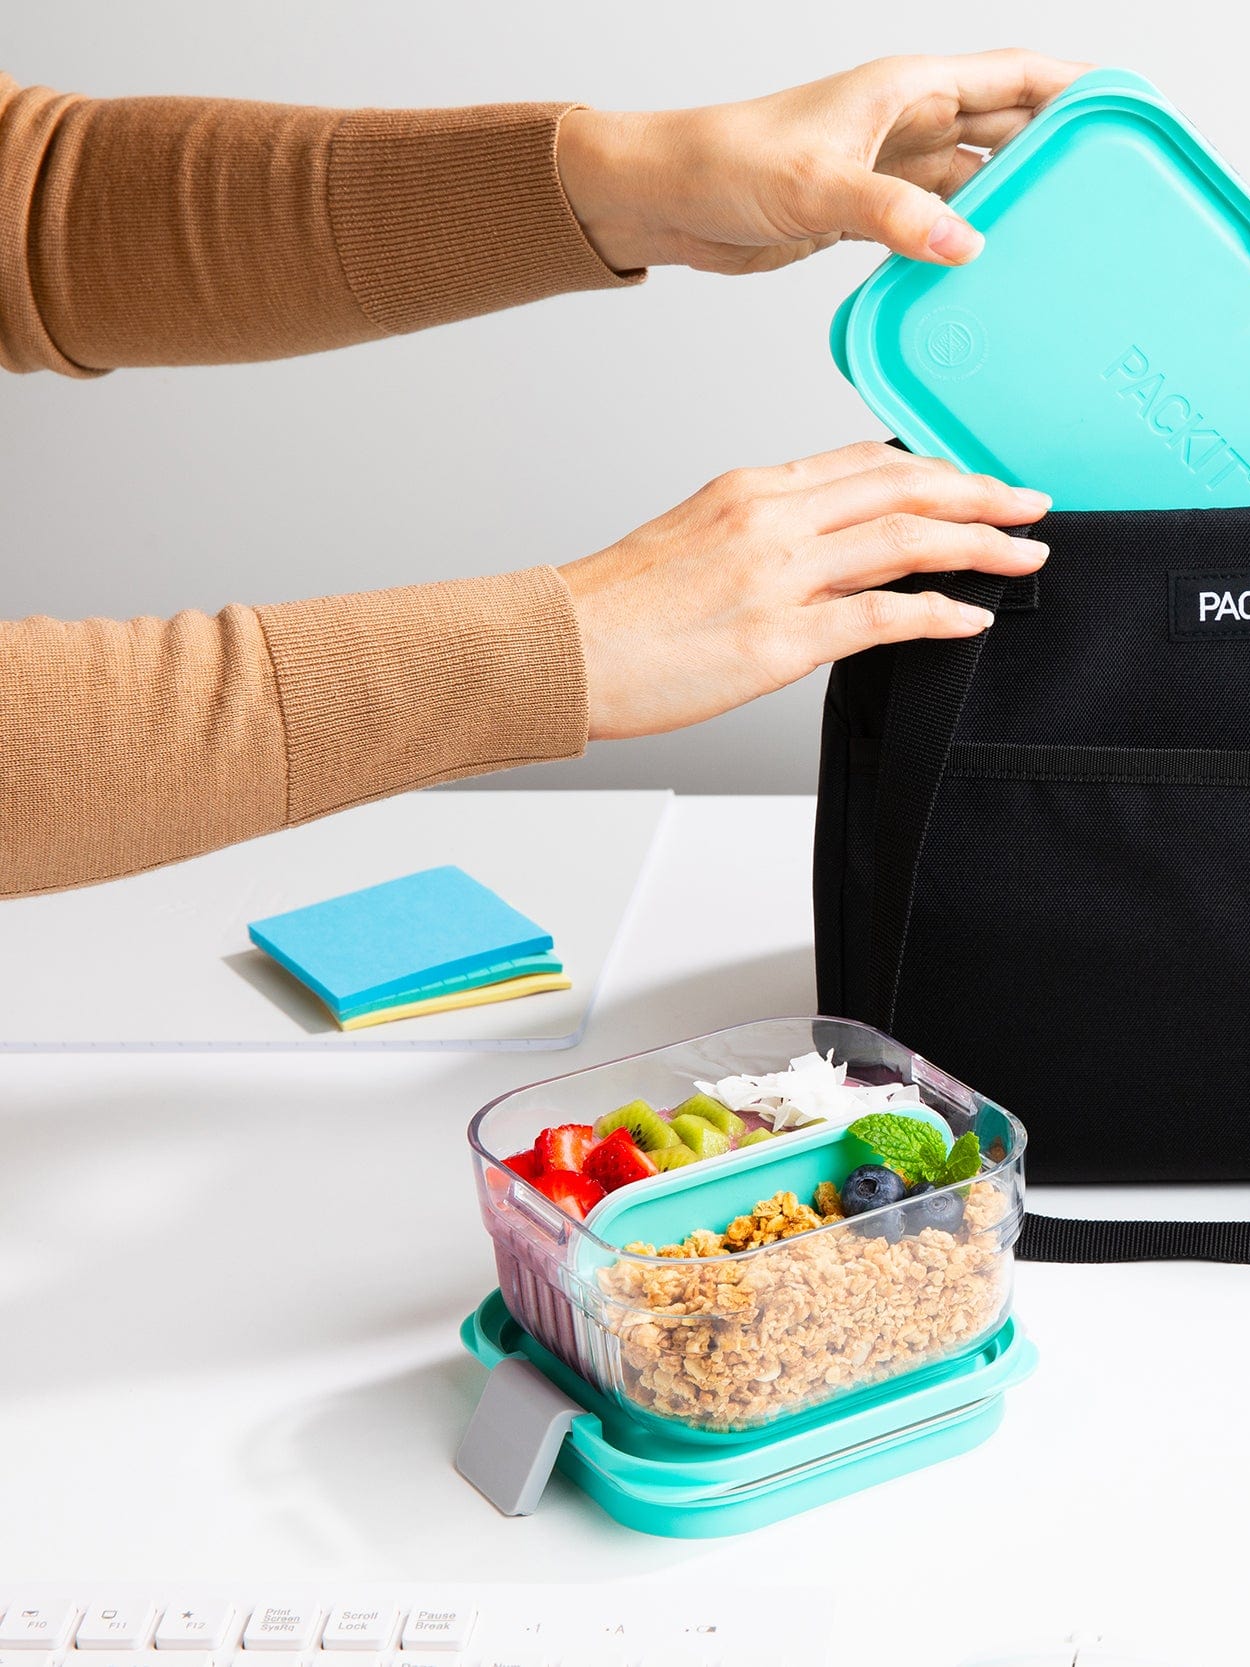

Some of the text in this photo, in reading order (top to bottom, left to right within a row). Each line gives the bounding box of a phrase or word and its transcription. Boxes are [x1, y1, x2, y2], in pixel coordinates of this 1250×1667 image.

[265, 1608, 291, 1616] Print
[342, 1611, 379, 1620] Scroll
[418, 1610, 457, 1620] Pause
[263, 1614, 301, 1623] Screen
[27, 1620, 48, 1629] F10
[108, 1621, 128, 1629] F11
[185, 1621, 206, 1629] F12
[260, 1623, 295, 1632] SysRq
[338, 1621, 368, 1630] Lock
[415, 1621, 451, 1630] Break
